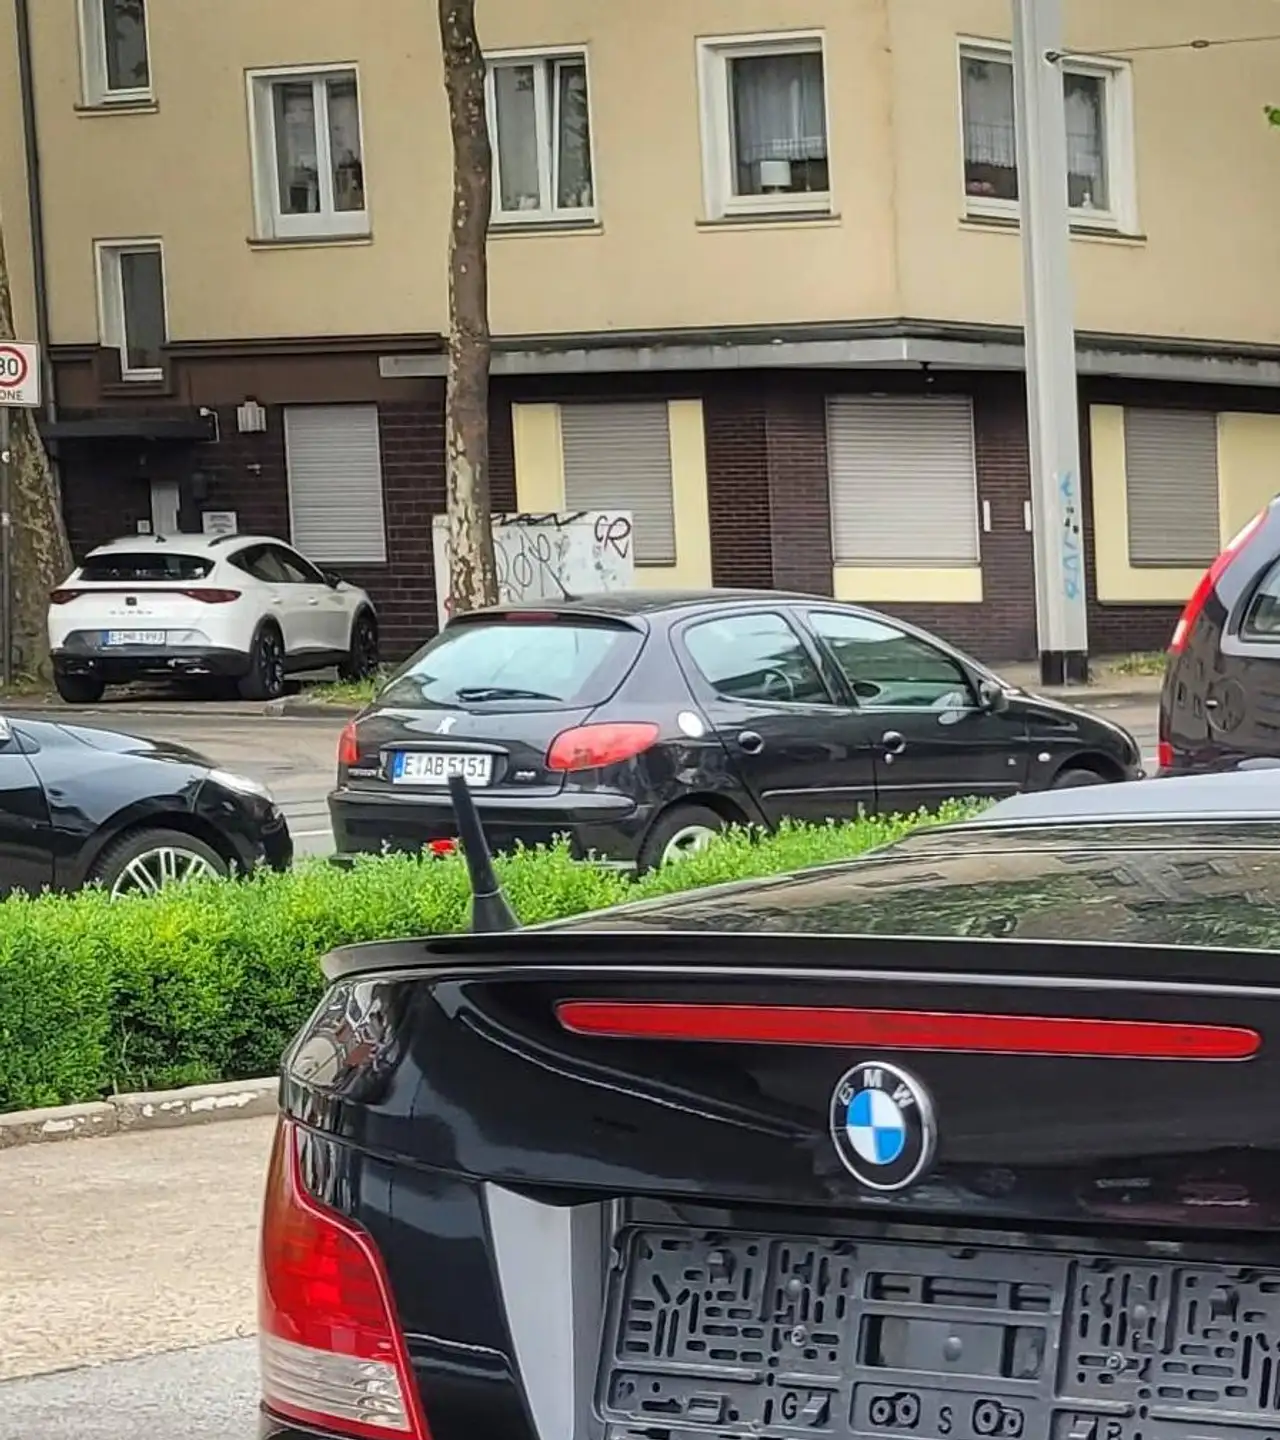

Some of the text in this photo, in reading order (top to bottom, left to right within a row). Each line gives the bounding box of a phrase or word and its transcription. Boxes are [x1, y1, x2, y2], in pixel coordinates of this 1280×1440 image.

[404, 756, 414, 776] E
[424, 757, 445, 777] AB
[838, 1068, 915, 1108] BMW
